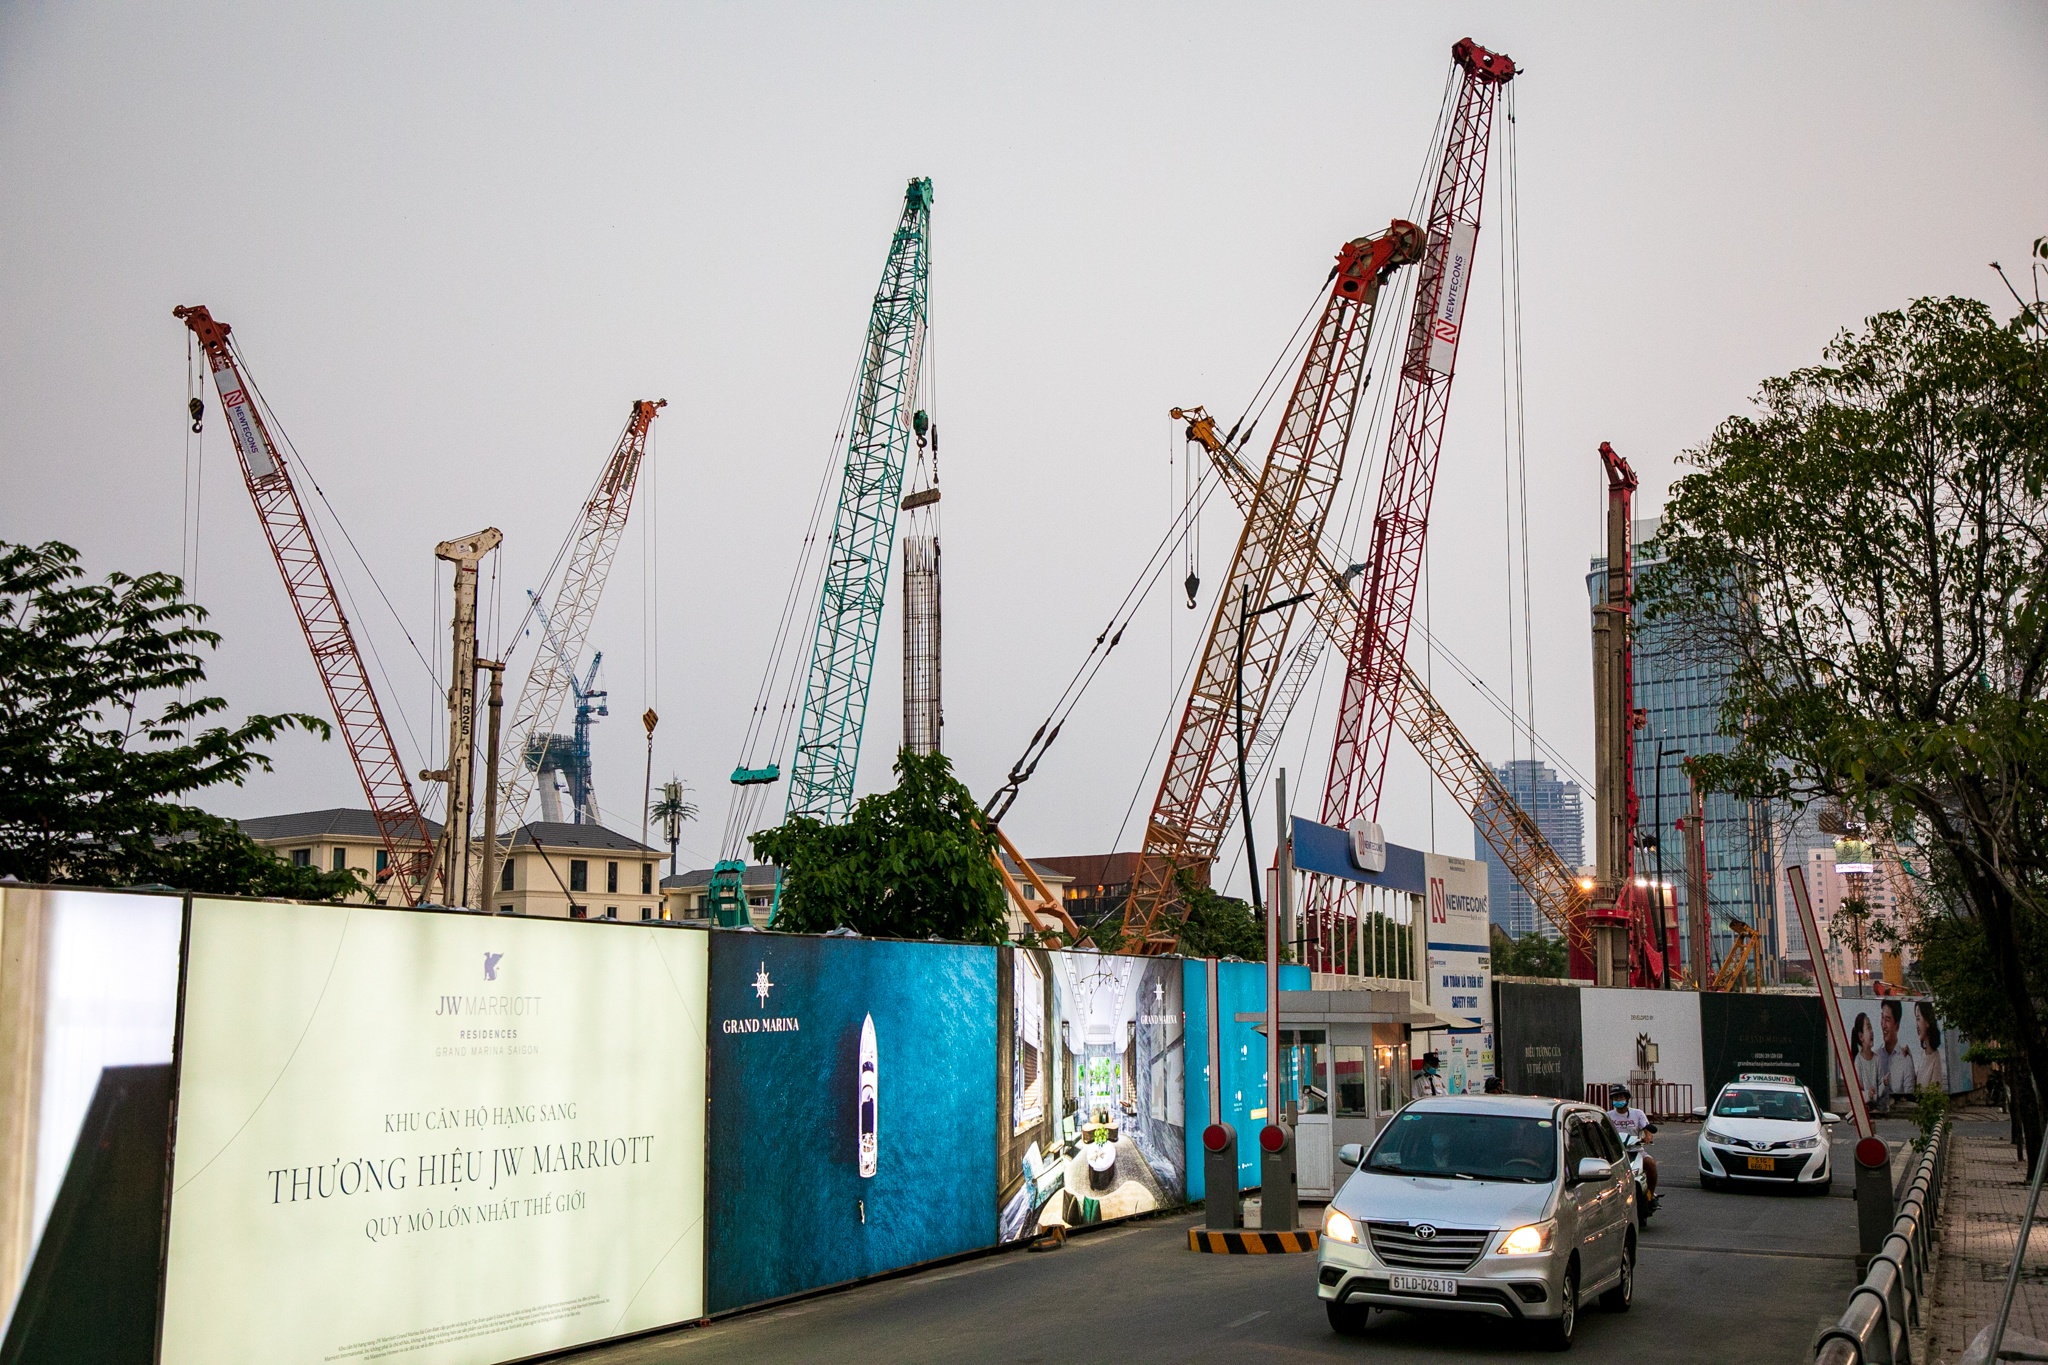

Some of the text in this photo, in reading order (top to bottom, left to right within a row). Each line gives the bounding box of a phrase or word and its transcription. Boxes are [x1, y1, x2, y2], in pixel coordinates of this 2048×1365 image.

[1445, 255, 1463, 321] NEWTECONS
[234, 405, 259, 454] NEWTECONS
[1446, 894, 1487, 913] NEWTECONS
[435, 996, 542, 1016] JW MARRIOTT
[1452, 996, 1477, 1008] SAFETY FIRST
[722, 1017, 799, 1033] GRAND MARINA
[1141, 1014, 1159, 1024] GRAND
[460, 1029, 517, 1039] RESIDENCES
[436, 1045, 539, 1057] GRAND MARINA SAIGON
[385, 1102, 577, 1133] KHU CĂN HỘ HẠNG SANG
[268, 1135, 654, 1205] THƯƠNG HIỆU JW MARRIOTT
[365, 1189, 585, 1243] QUY MÔ LỚN NHẤT THẾ GIỚI
[1394, 1276, 1453, 1292] 61LD-029.18
